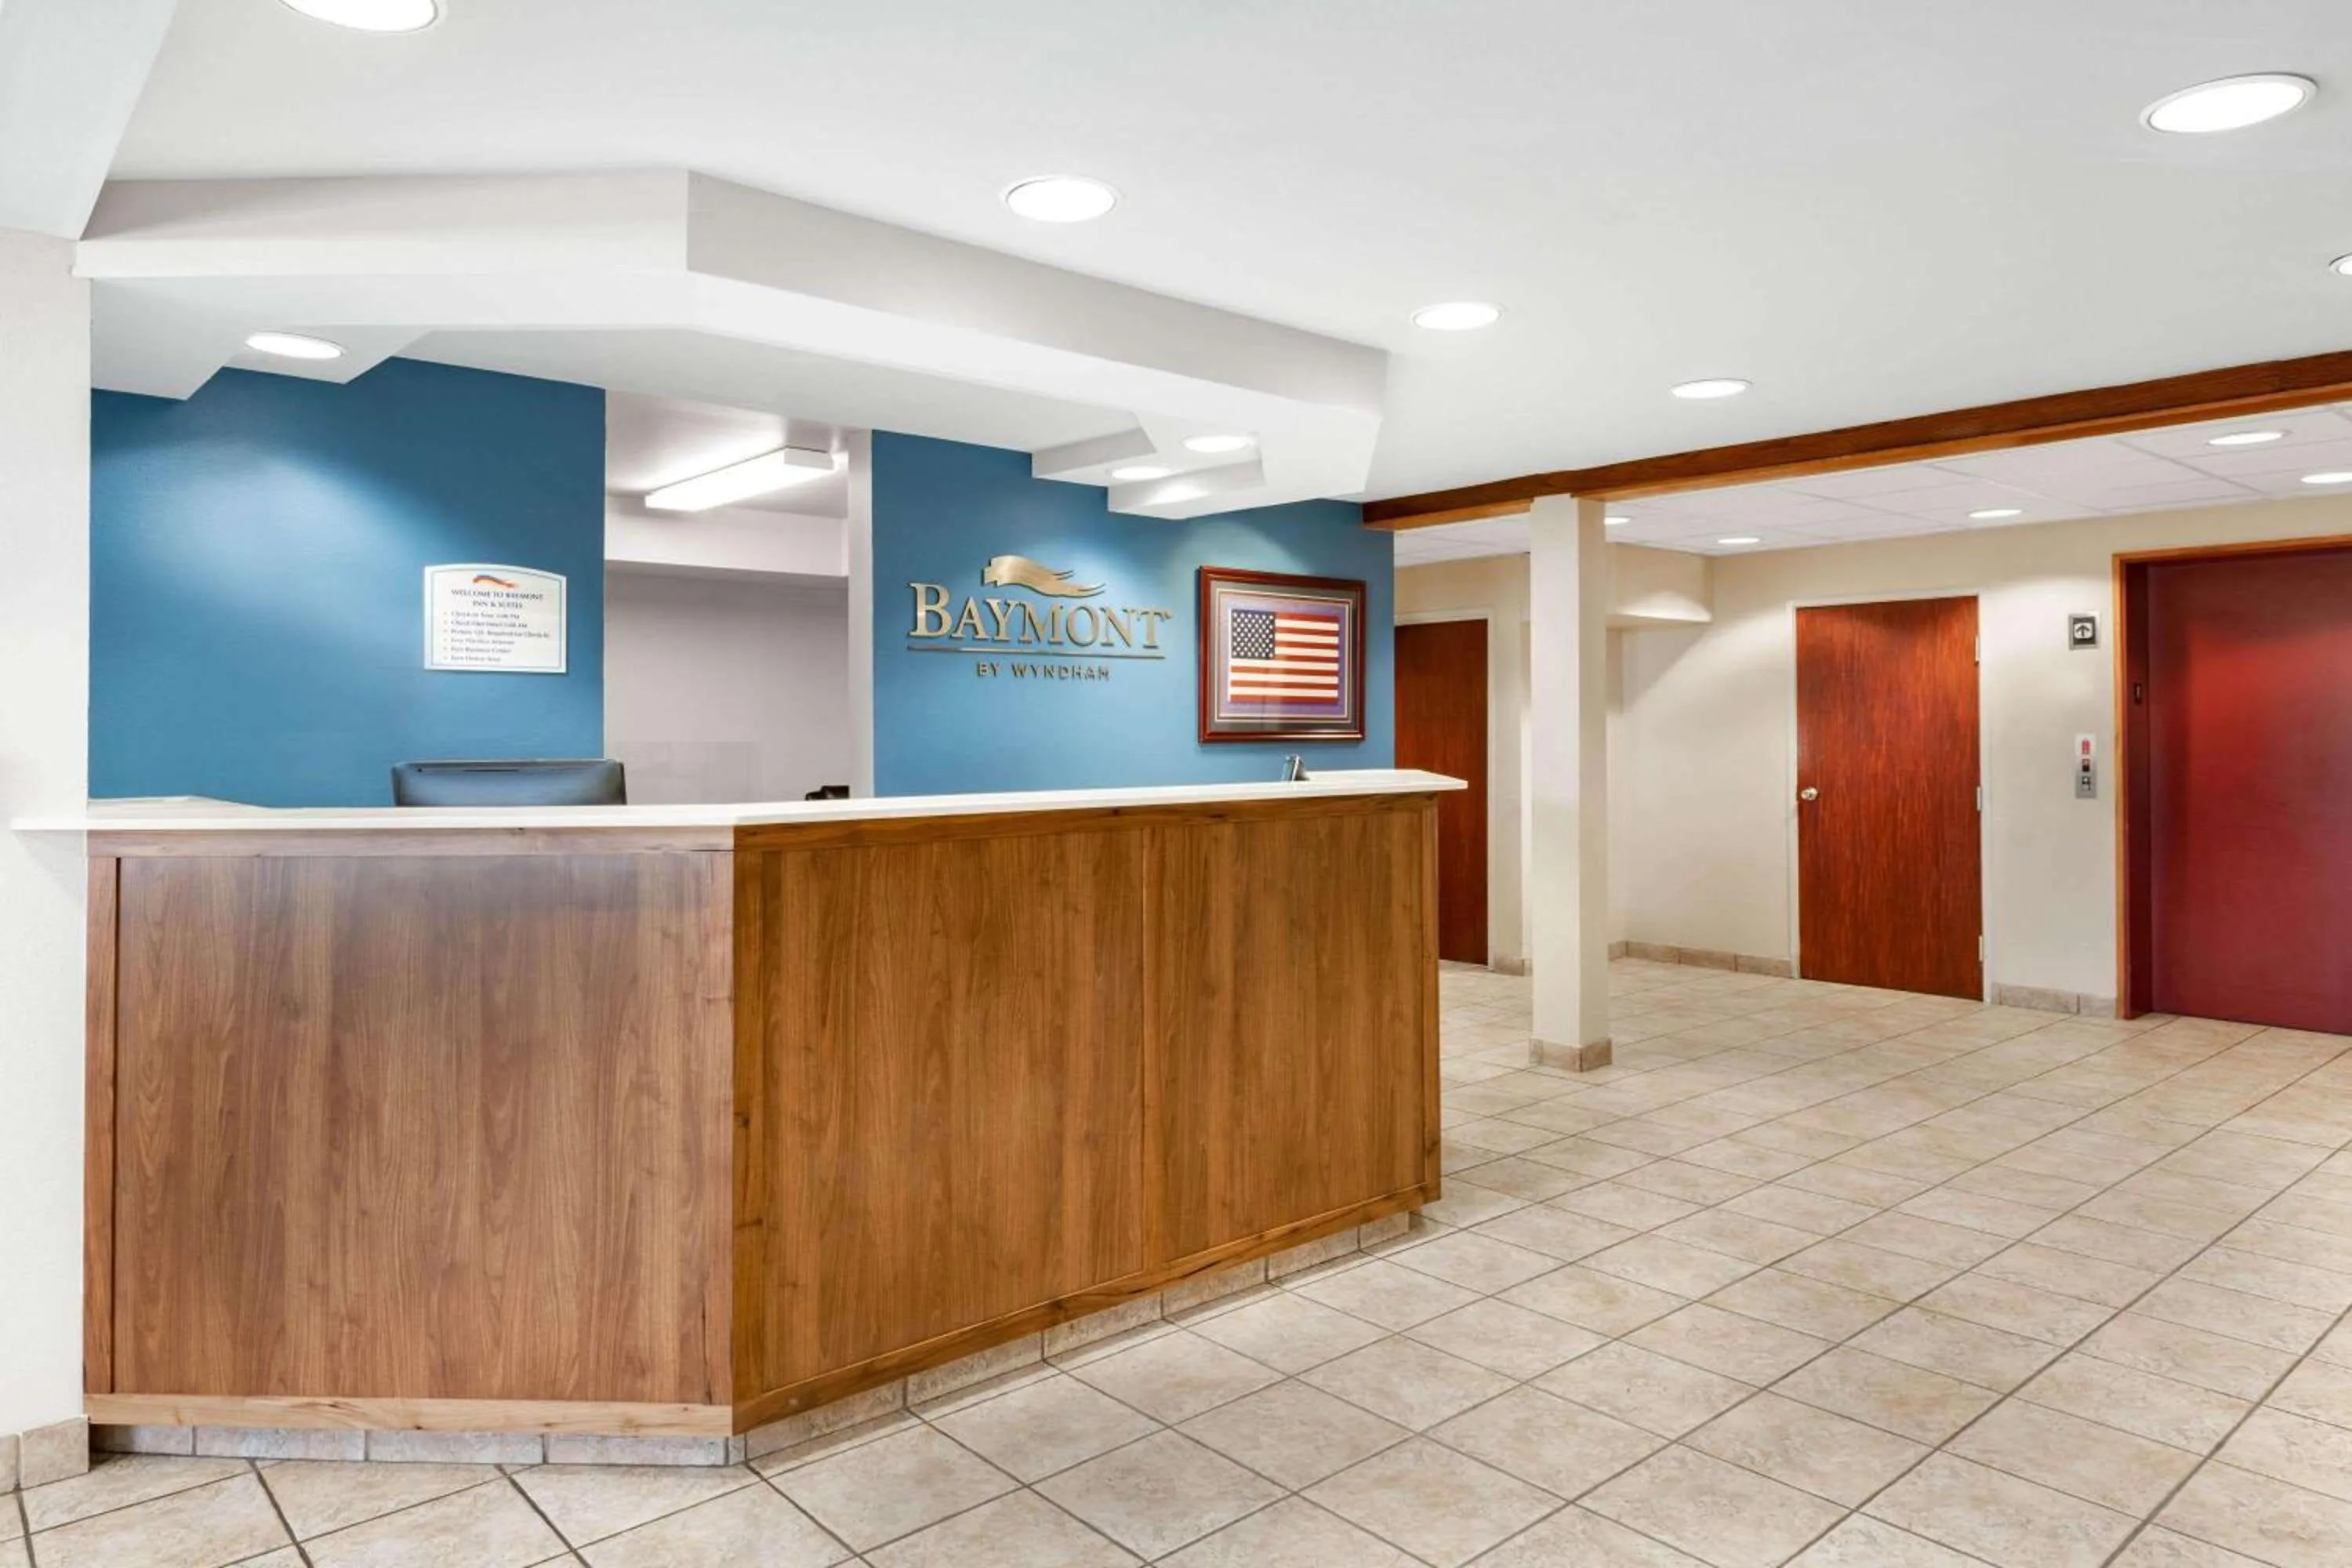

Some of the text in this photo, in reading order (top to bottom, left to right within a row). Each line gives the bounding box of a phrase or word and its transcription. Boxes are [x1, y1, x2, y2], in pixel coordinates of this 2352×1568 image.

[908, 582, 1170, 648] BAYMONT
[977, 662, 1109, 681] BY WYNDHAM
